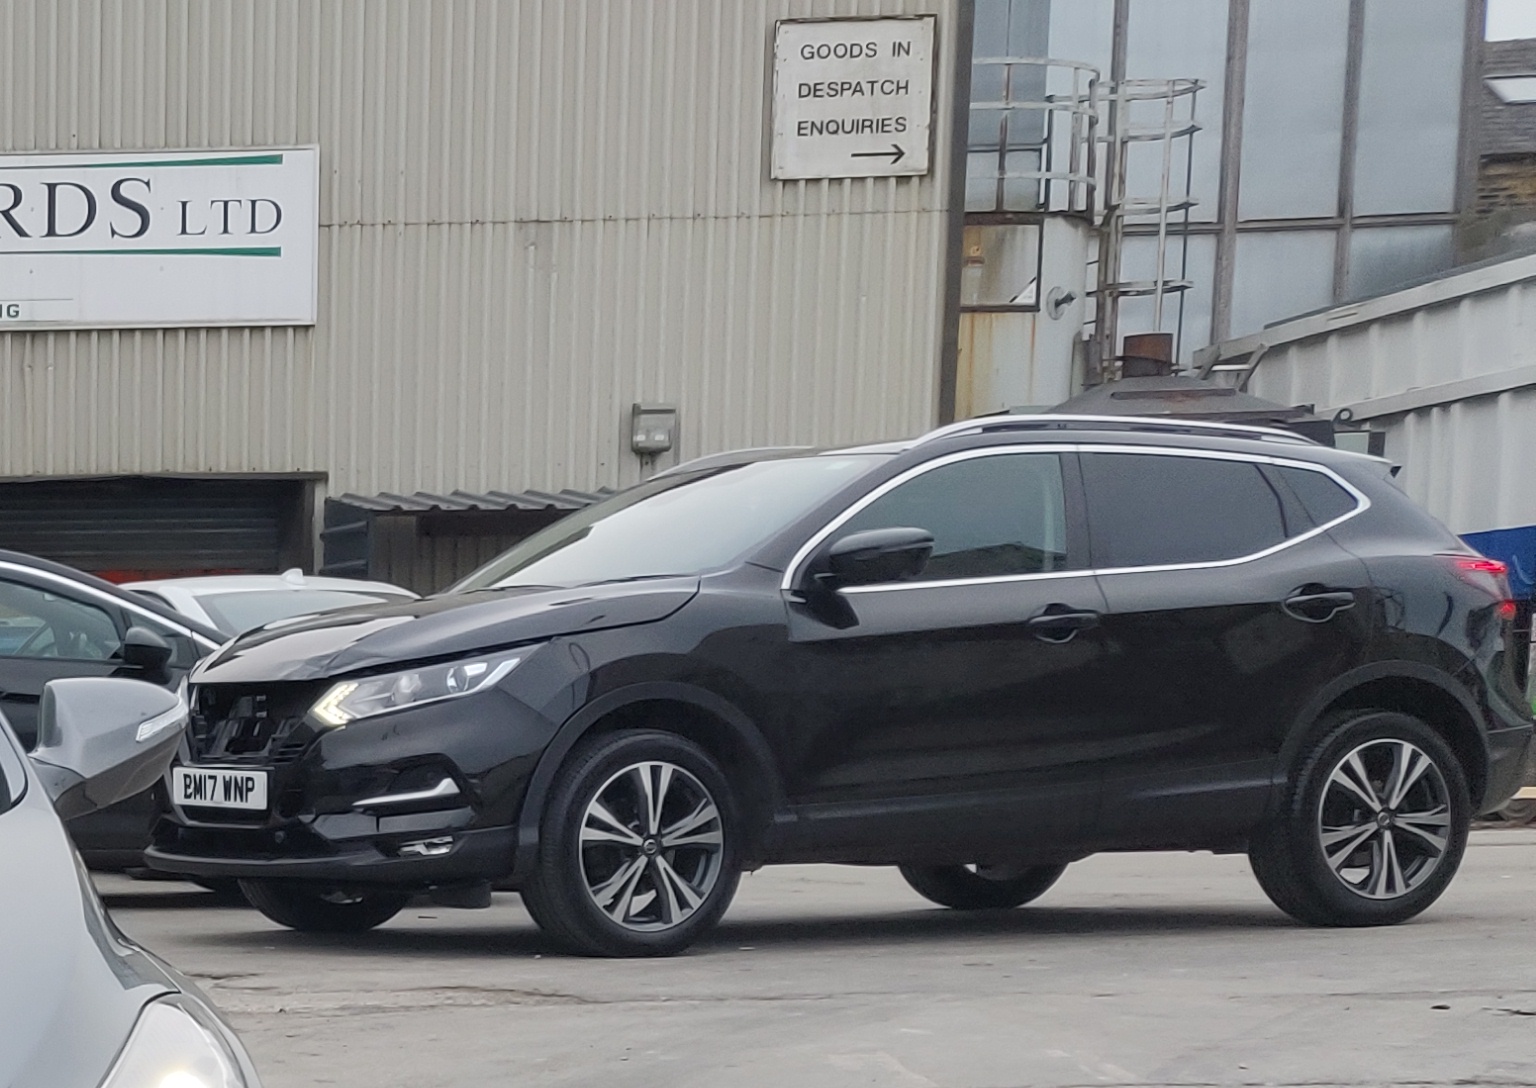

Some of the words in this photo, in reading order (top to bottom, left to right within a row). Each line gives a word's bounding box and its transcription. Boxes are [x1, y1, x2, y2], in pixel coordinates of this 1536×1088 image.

[800, 42, 878, 60] GOODS
[891, 41, 912, 58] IN
[797, 79, 910, 99] DESPATCH
[796, 116, 908, 137] ENQUIRIES
[176, 198, 283, 237] LTD
[183, 773, 218, 801] BM17
